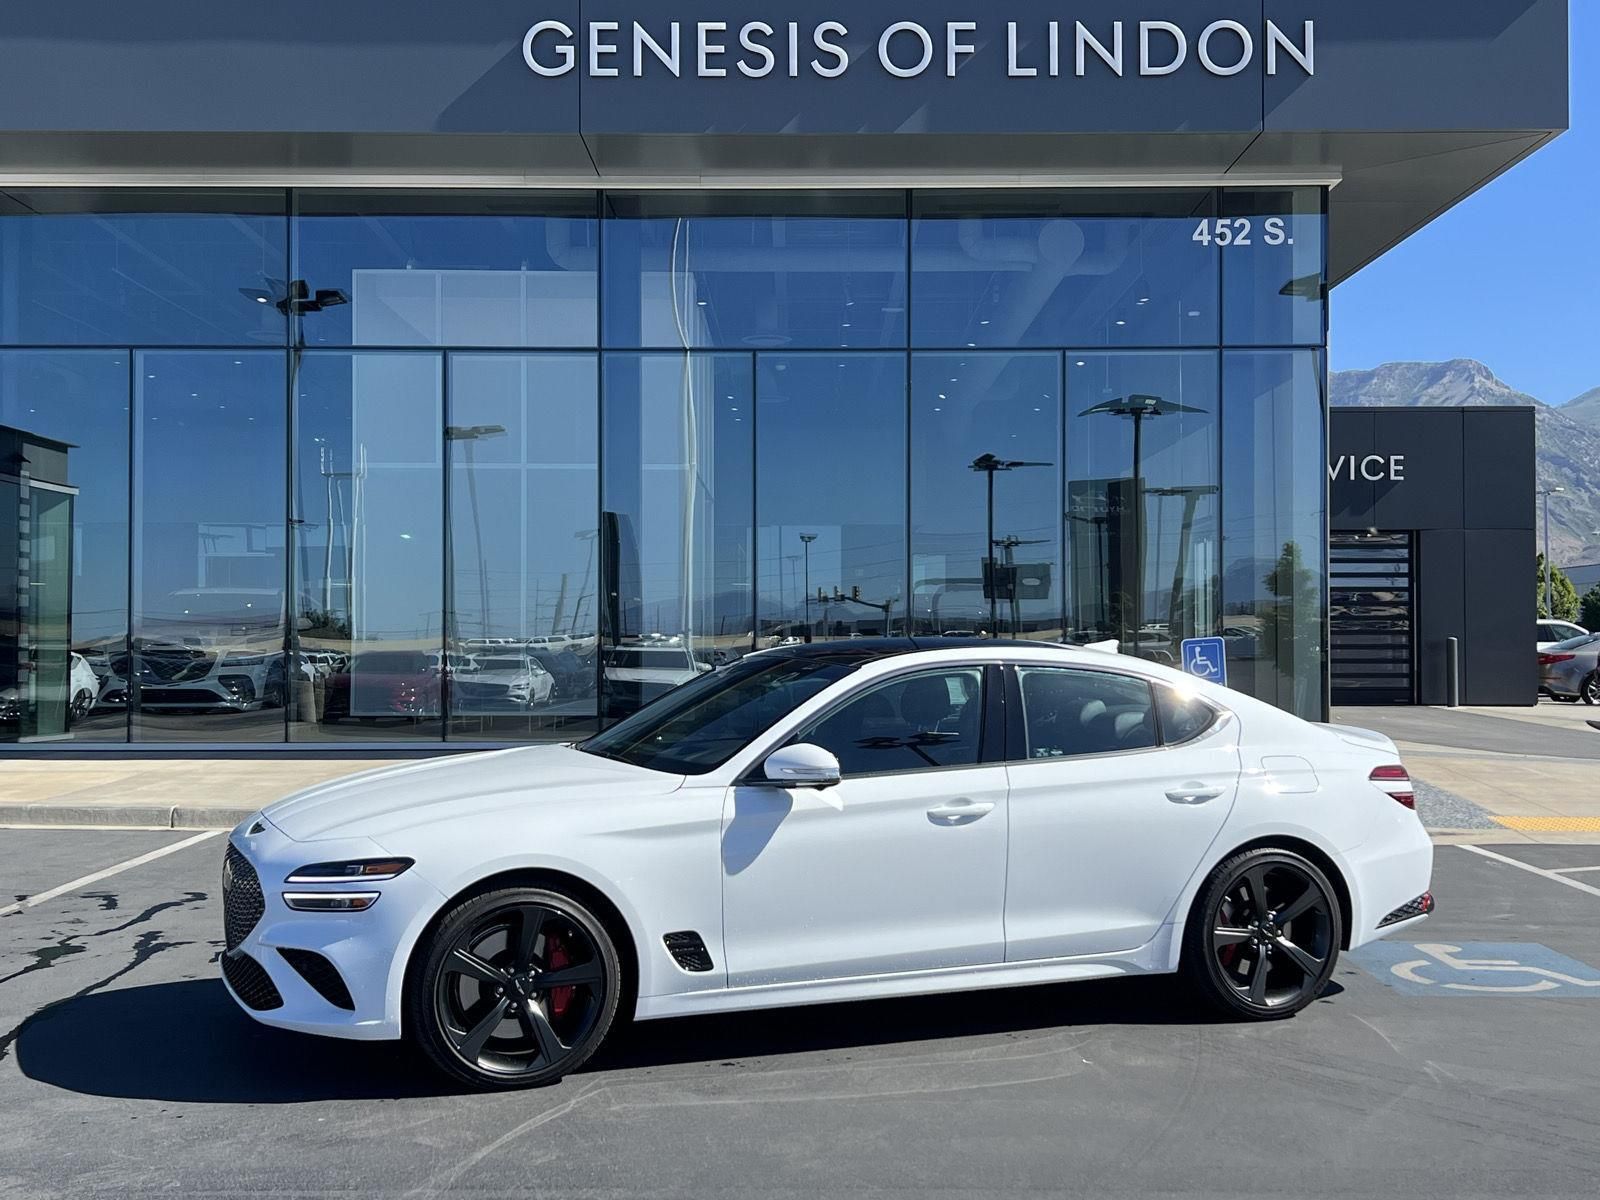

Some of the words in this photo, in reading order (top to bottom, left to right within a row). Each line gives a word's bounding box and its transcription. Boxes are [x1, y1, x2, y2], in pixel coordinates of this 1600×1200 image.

[522, 20, 849, 78] GENESIS
[878, 20, 977, 78] OF
[1007, 19, 1315, 77] LINDON
[1192, 218, 1251, 246] 452
[1263, 217, 1294, 245] S.
[1328, 454, 1405, 481] VICE
